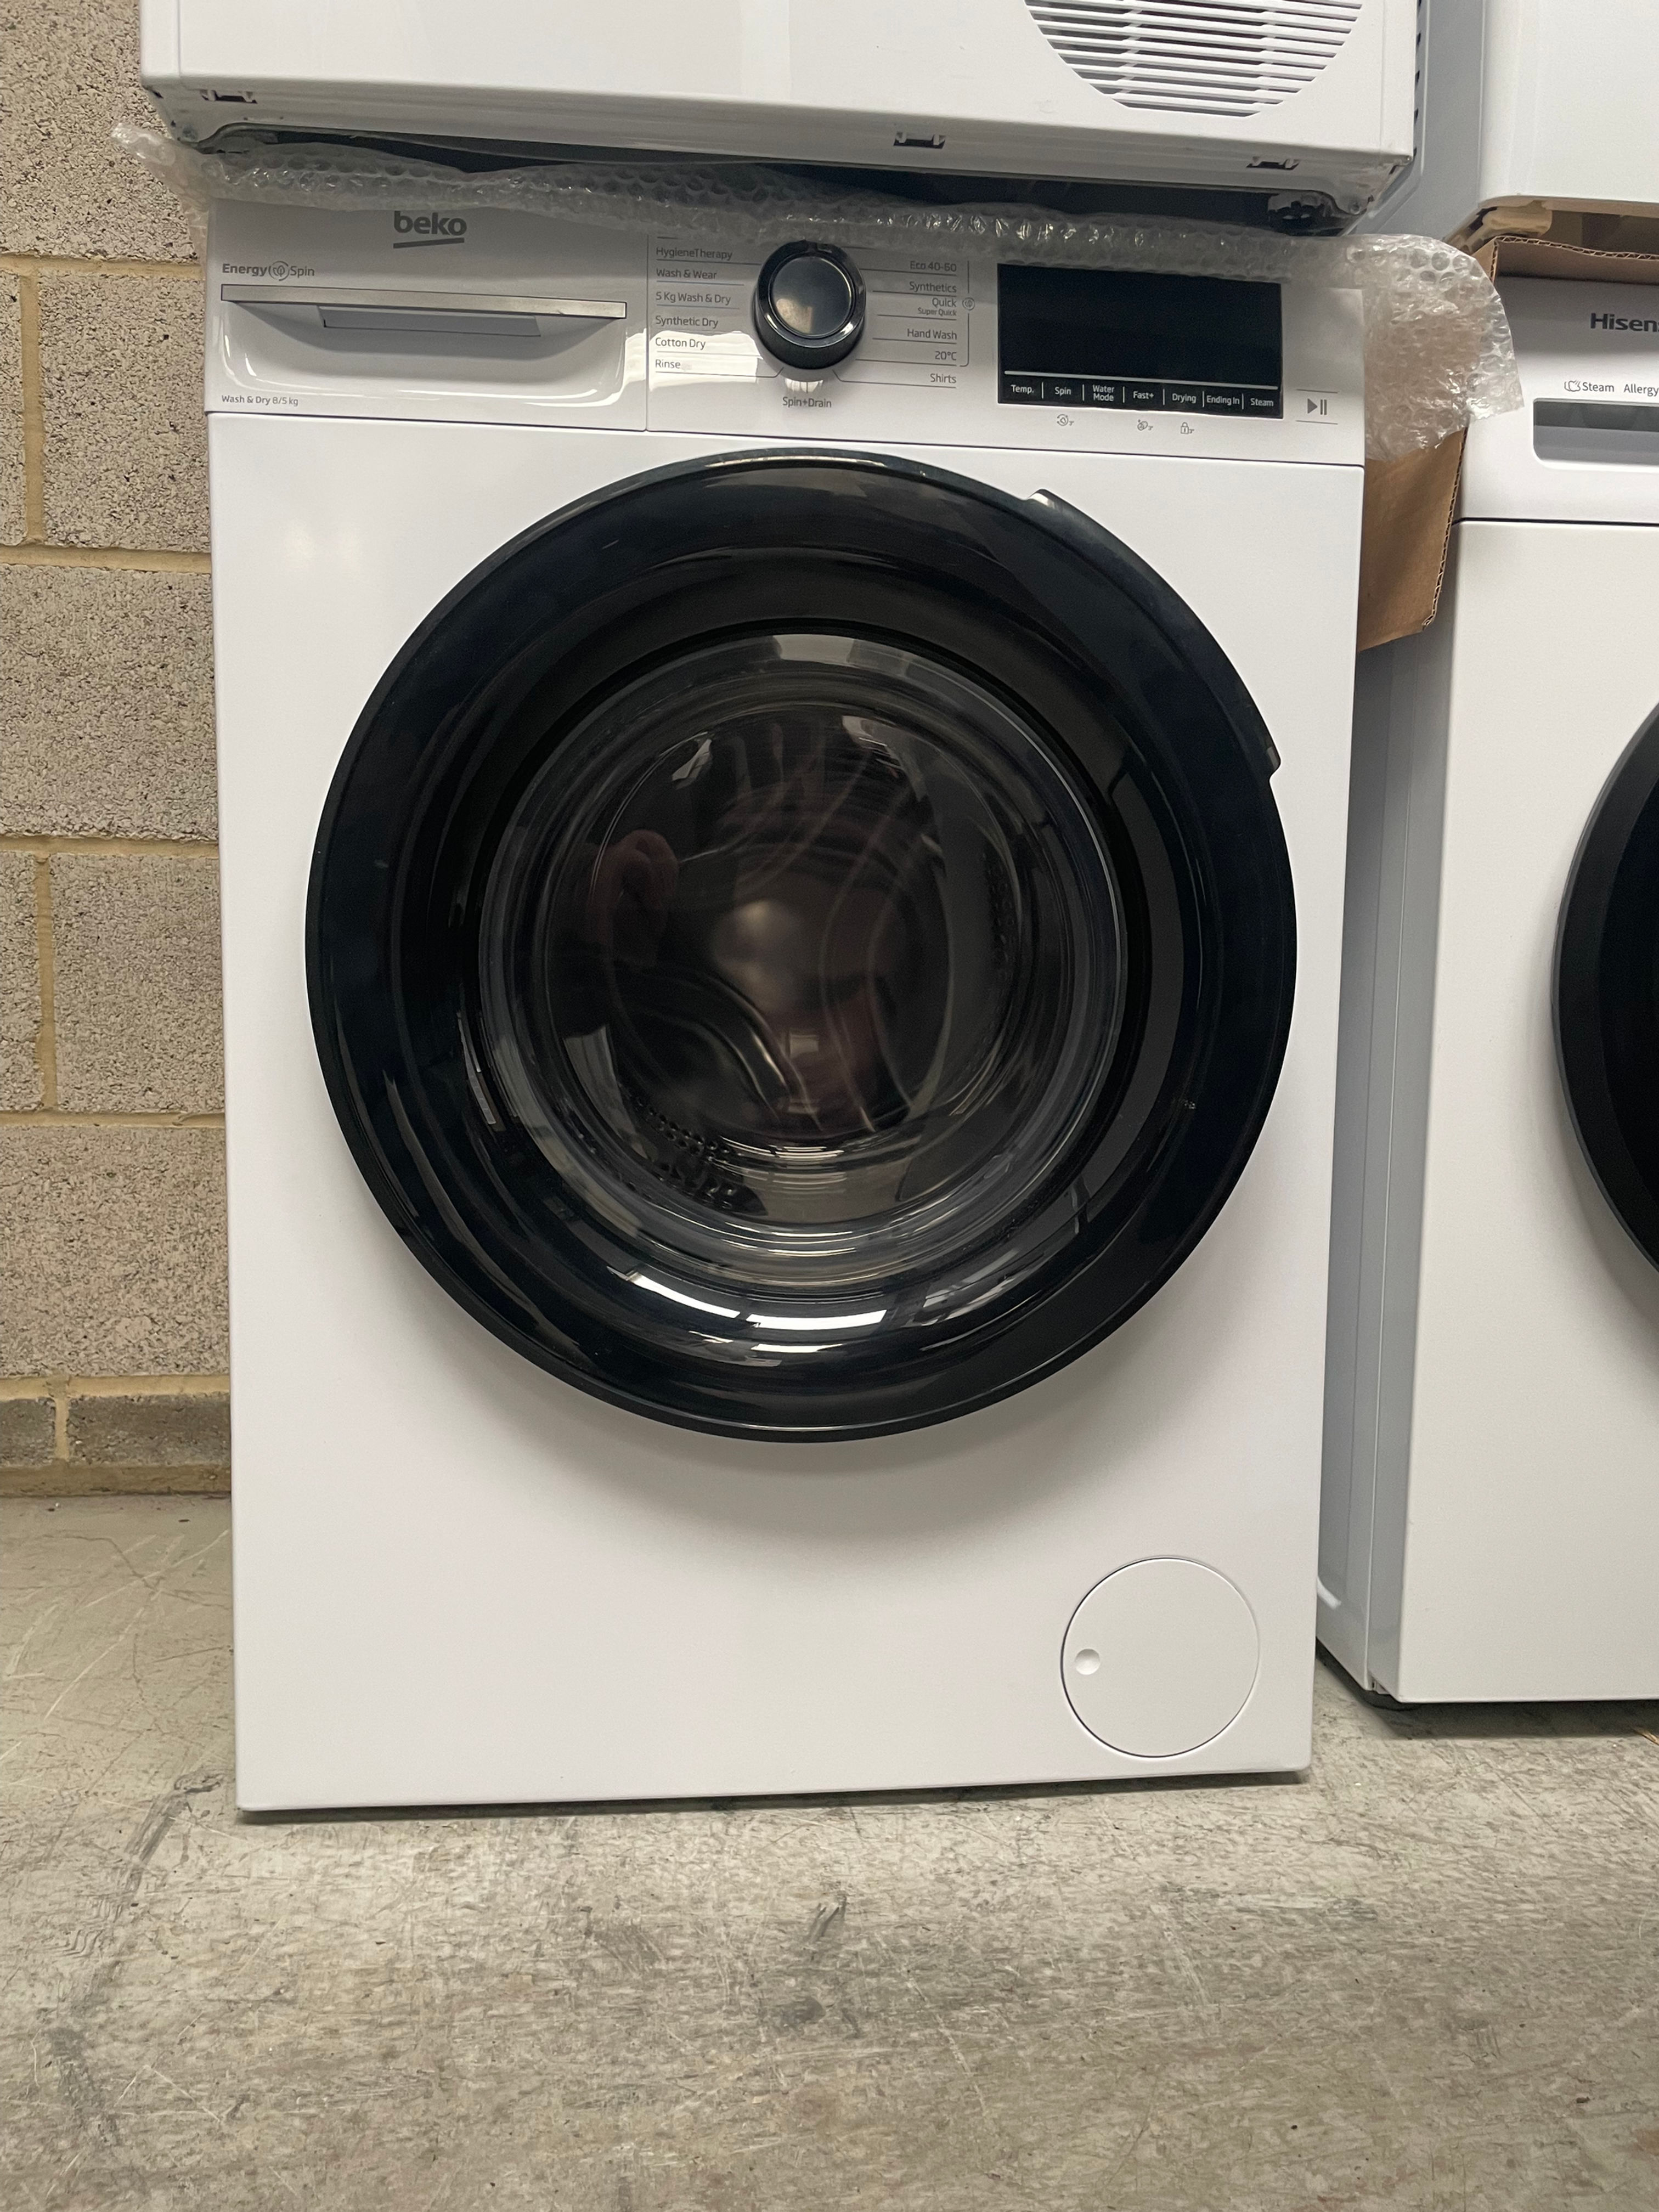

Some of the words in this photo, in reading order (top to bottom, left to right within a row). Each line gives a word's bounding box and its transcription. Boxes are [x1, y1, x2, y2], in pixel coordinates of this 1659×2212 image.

[394, 211, 467, 236] beko
[656, 247, 732, 261] HygieneTherapy
[222, 263, 267, 276] Energy
[290, 266, 315, 278] Spin
[910, 261, 926, 270] Eco
[928, 262, 957, 272] 40-60
[656, 269, 681, 278] Wash
[684, 269, 691, 278] &
[693, 270, 717, 279] Wear
[909, 281, 957, 293] Synthetics
[656, 291, 662, 301] 5
[663, 292, 675, 303] Kg
[678, 292, 703, 302] Wash
[705, 294, 713, 303] &
[714, 295, 731, 306] Dry
[932, 298, 957, 308] Quick
[655, 315, 700, 326] Synthetic
[702, 318, 719, 329] Dry
[1590, 313, 1659, 332] Hisen
[907, 329, 931, 338] Hand
[933, 330, 957, 340] Wash
[655, 337, 687, 347] Cotton
[689, 339, 706, 350] Dry
[935, 351, 957, 360] 20°C
[655, 359, 681, 369] Rinse
[930, 373, 957, 383] Shirts
[1011, 384, 1034, 393] Temp.
[1054, 387, 1071, 396] Spin
[1092, 384, 1114, 393] Water
[1582, 382, 1615, 392] Steam
[1624, 384, 1659, 397] Allergy
[1093, 393, 1114, 402] Mode
[1133, 391, 1154, 399] Fast+
[1172, 393, 1196, 404] Drying
[1206, 395, 1232, 406] Ending
[1232, 396, 1240, 405] In
[222, 395, 245, 403] Wash
[255, 396, 270, 405] Dry
[289, 397, 298, 407] kg
[782, 397, 832, 408] Spin+Drain
[1250, 398, 1274, 407] Steam
